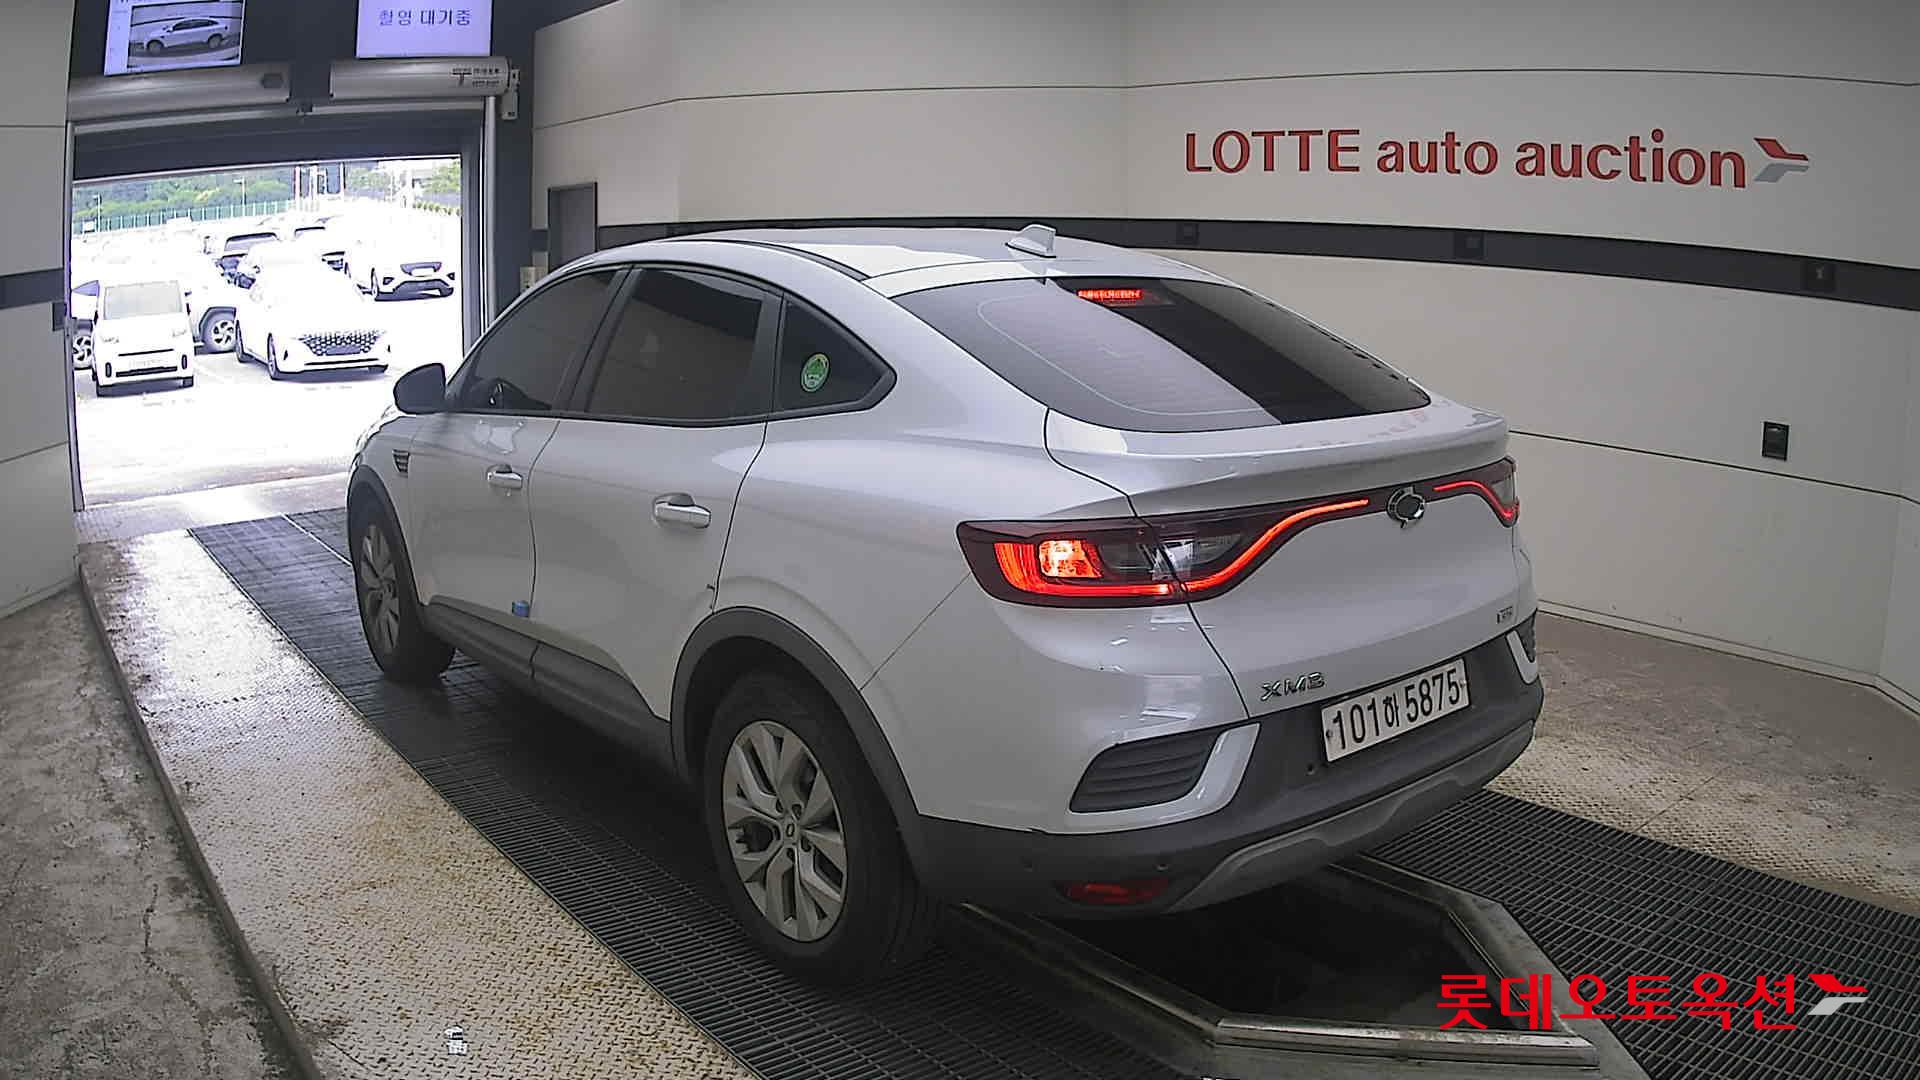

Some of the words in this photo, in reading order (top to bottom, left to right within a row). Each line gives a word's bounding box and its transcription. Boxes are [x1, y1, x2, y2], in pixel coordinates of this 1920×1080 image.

[420, 9, 471, 26] 대기중
[1186, 129, 1361, 173] LOTTE
[1376, 131, 1499, 176] auto
[1514, 128, 1746, 188] auction
